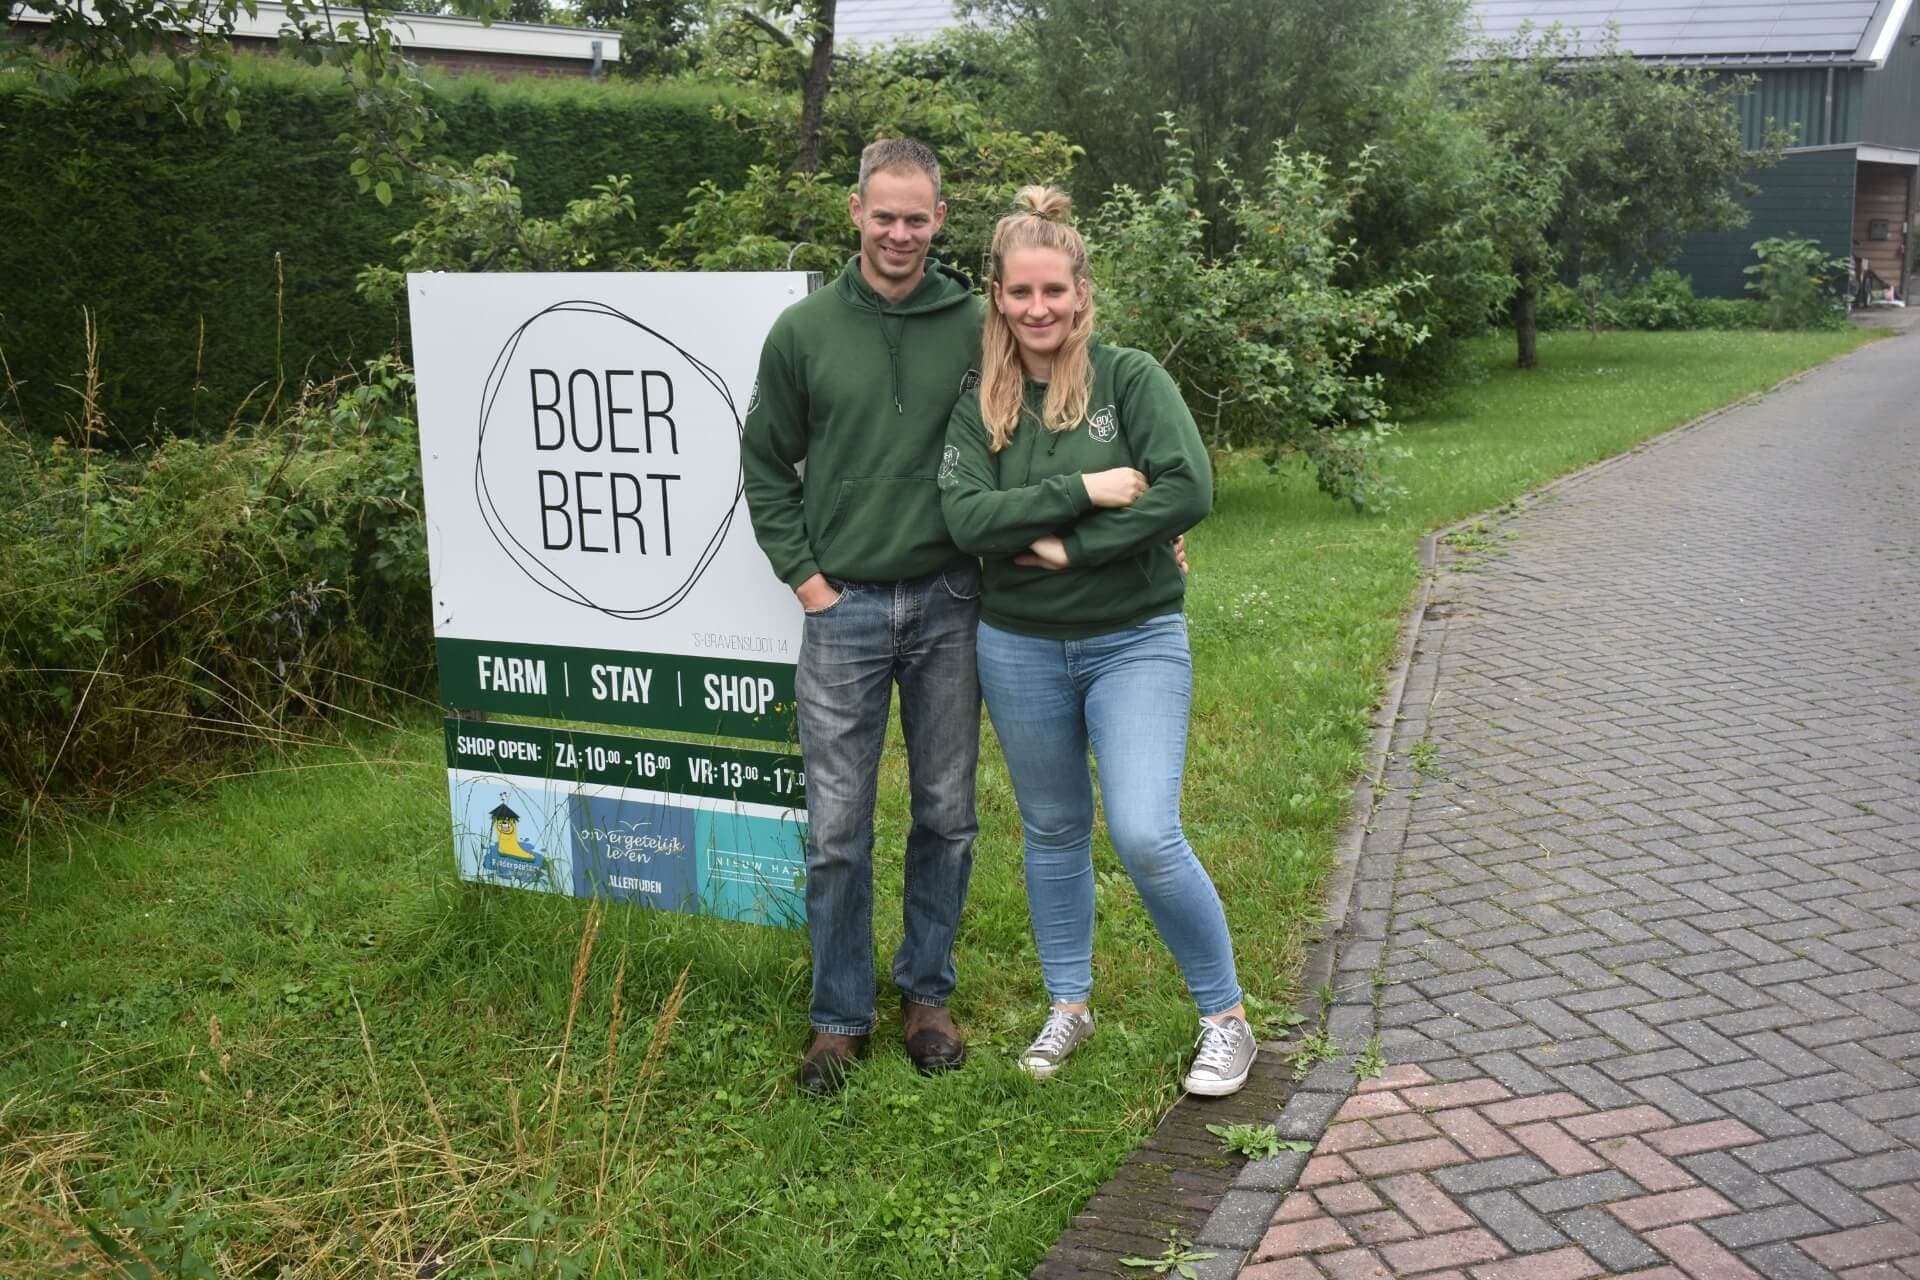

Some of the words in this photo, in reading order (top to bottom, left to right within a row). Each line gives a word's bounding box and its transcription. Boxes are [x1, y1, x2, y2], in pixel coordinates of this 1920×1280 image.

[530, 368, 679, 455] BOER
[538, 469, 681, 557] BERT
[777, 639, 788, 655] 14
[477, 655, 548, 696] FARM
[590, 664, 653, 704] STAY
[703, 673, 775, 715] SHOP
[457, 735, 495, 757] SHOP
[498, 739, 542, 762] OPEN:
[606, 843, 652, 864] leven
